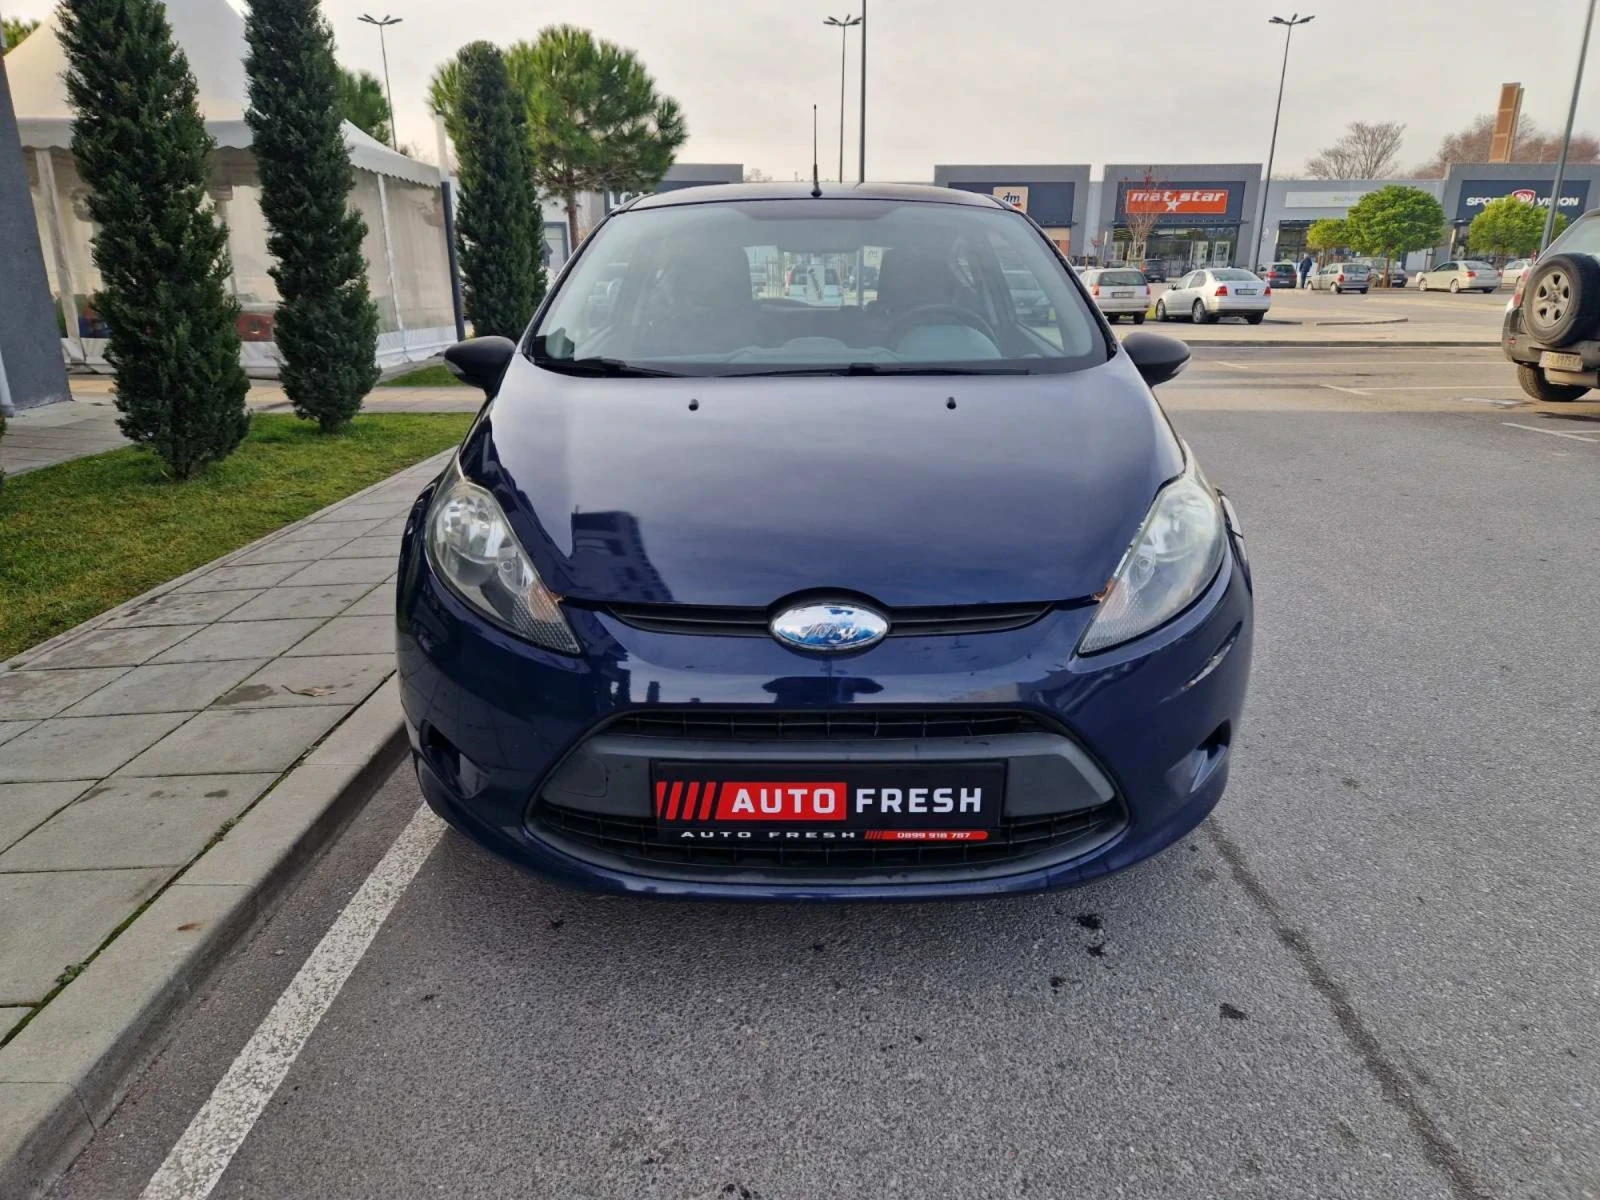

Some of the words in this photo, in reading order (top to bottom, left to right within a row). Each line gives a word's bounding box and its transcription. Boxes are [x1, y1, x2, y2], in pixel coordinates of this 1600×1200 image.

[1002, 191, 1020, 203] dm
[1131, 191, 1173, 202] mat
[1179, 191, 1225, 202] star
[1537, 197, 1580, 206] VION
[731, 788, 836, 814] AUTO
[856, 787, 982, 813] FRESH
[681, 831, 752, 839] AUTO
[769, 831, 856, 839] FRESH
[897, 831, 926, 839] 0899
